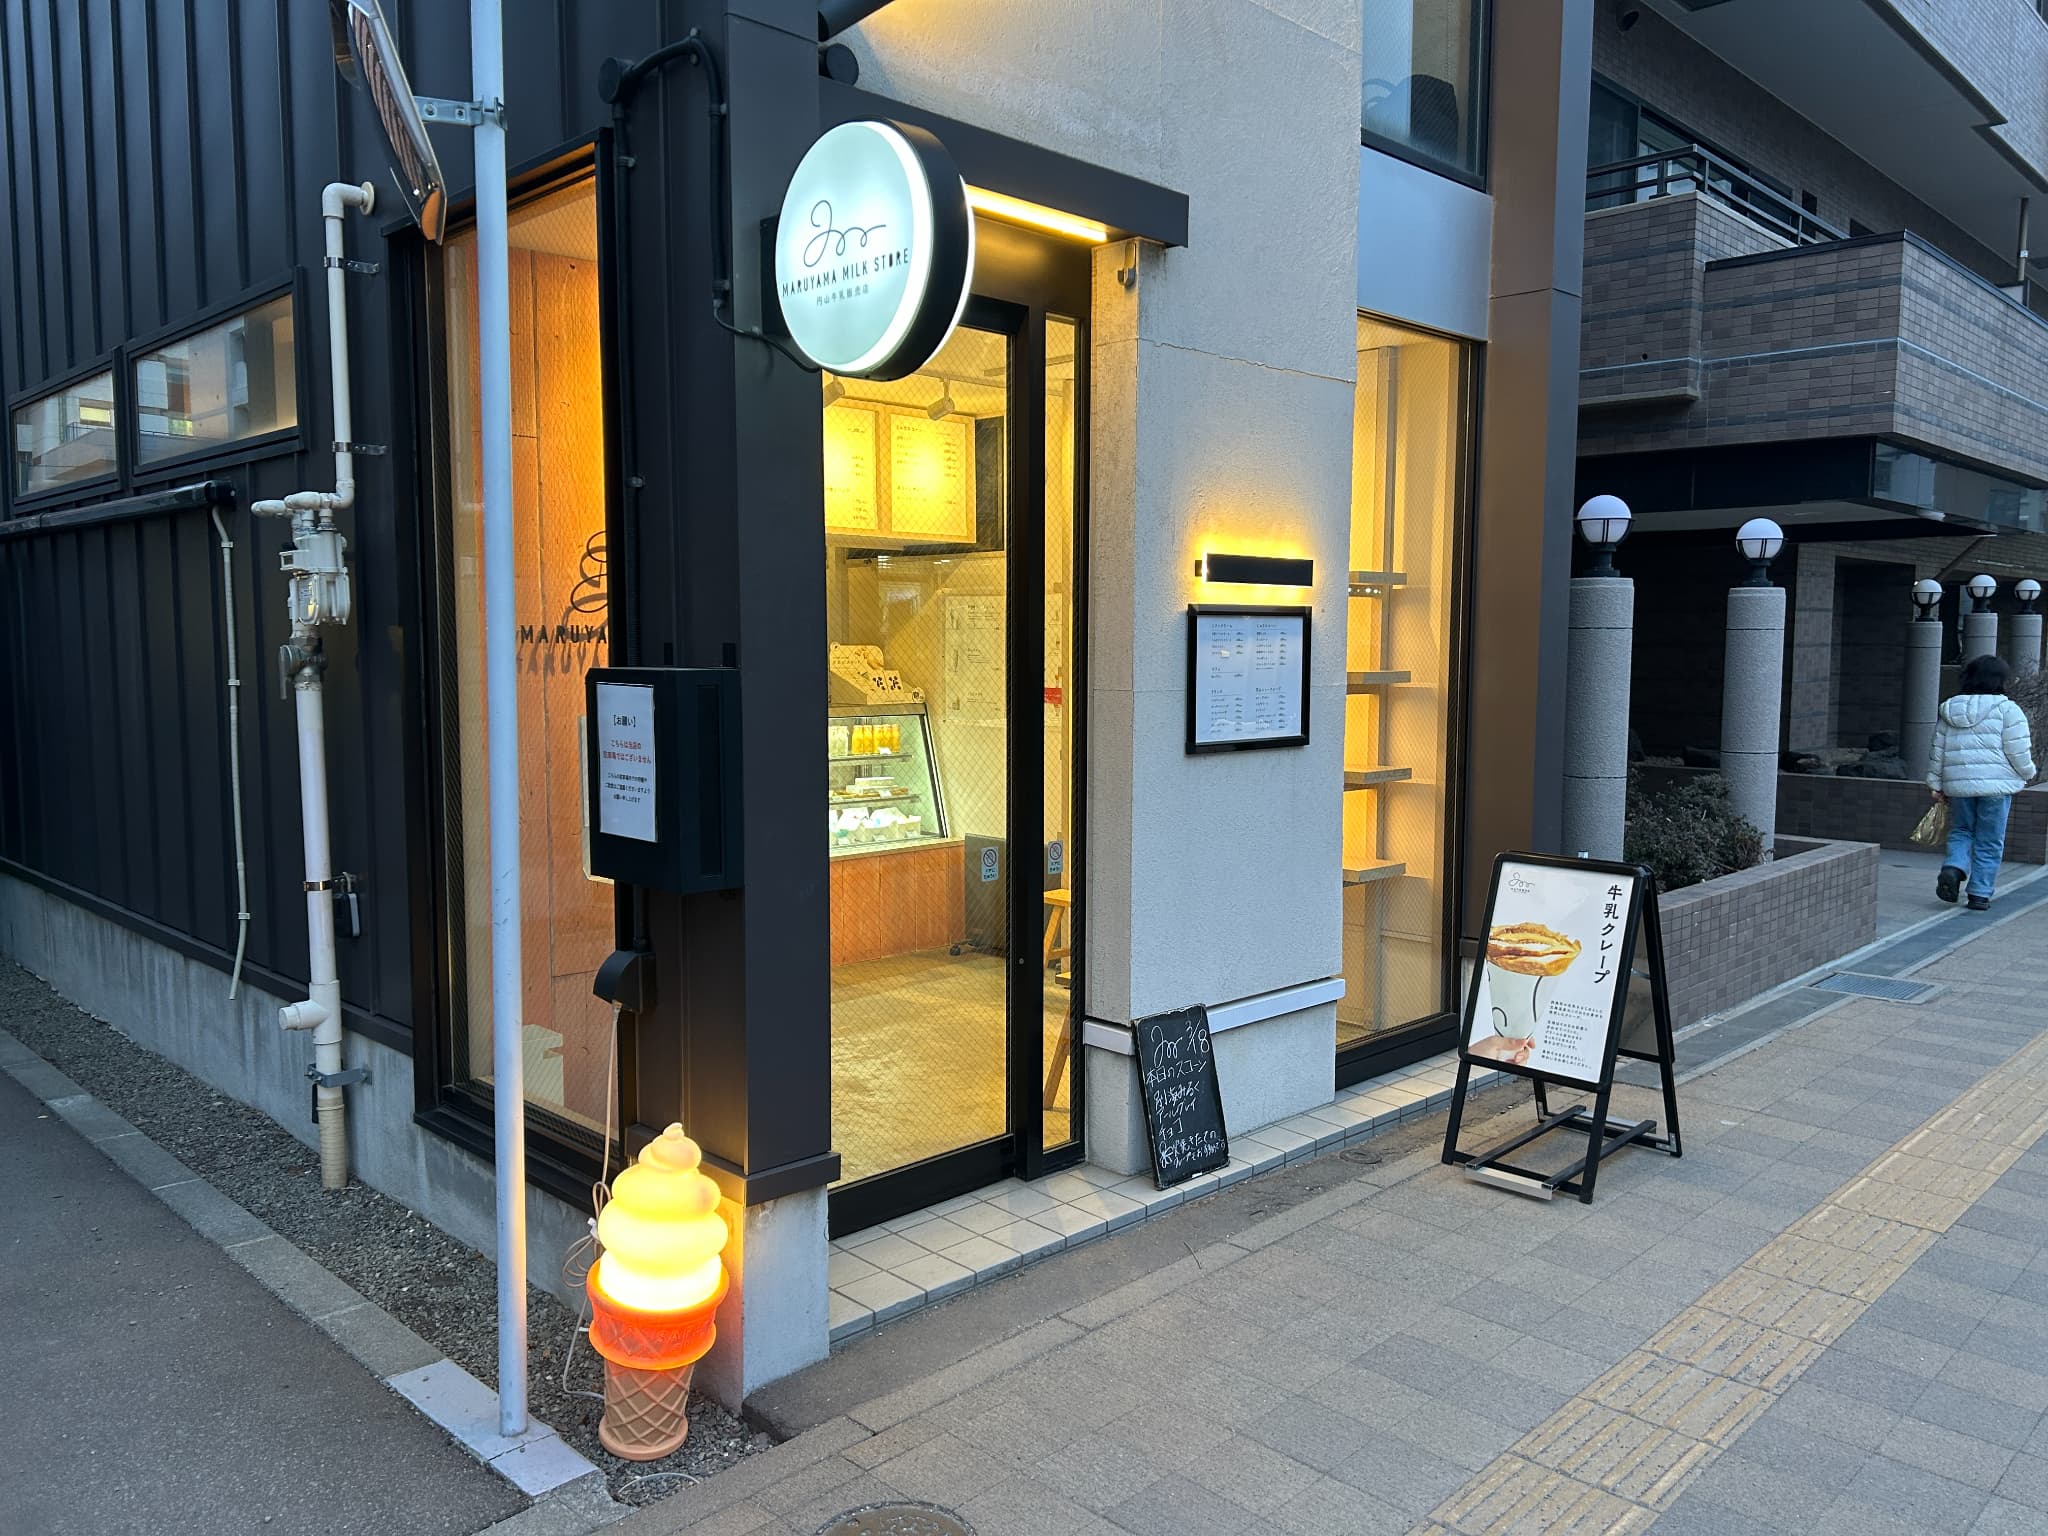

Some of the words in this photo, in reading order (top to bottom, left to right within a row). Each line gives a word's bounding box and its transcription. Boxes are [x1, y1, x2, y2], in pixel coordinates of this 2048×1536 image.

[782, 269, 837, 298] MARUYAMA
[842, 260, 868, 280] MILK
[874, 247, 909, 272] STORE
[1594, 884, 1623, 984] 牛乳クレープ
[1146, 1060, 1207, 1087] 本日のスコーン
[1158, 1117, 1183, 1140] チョコ
